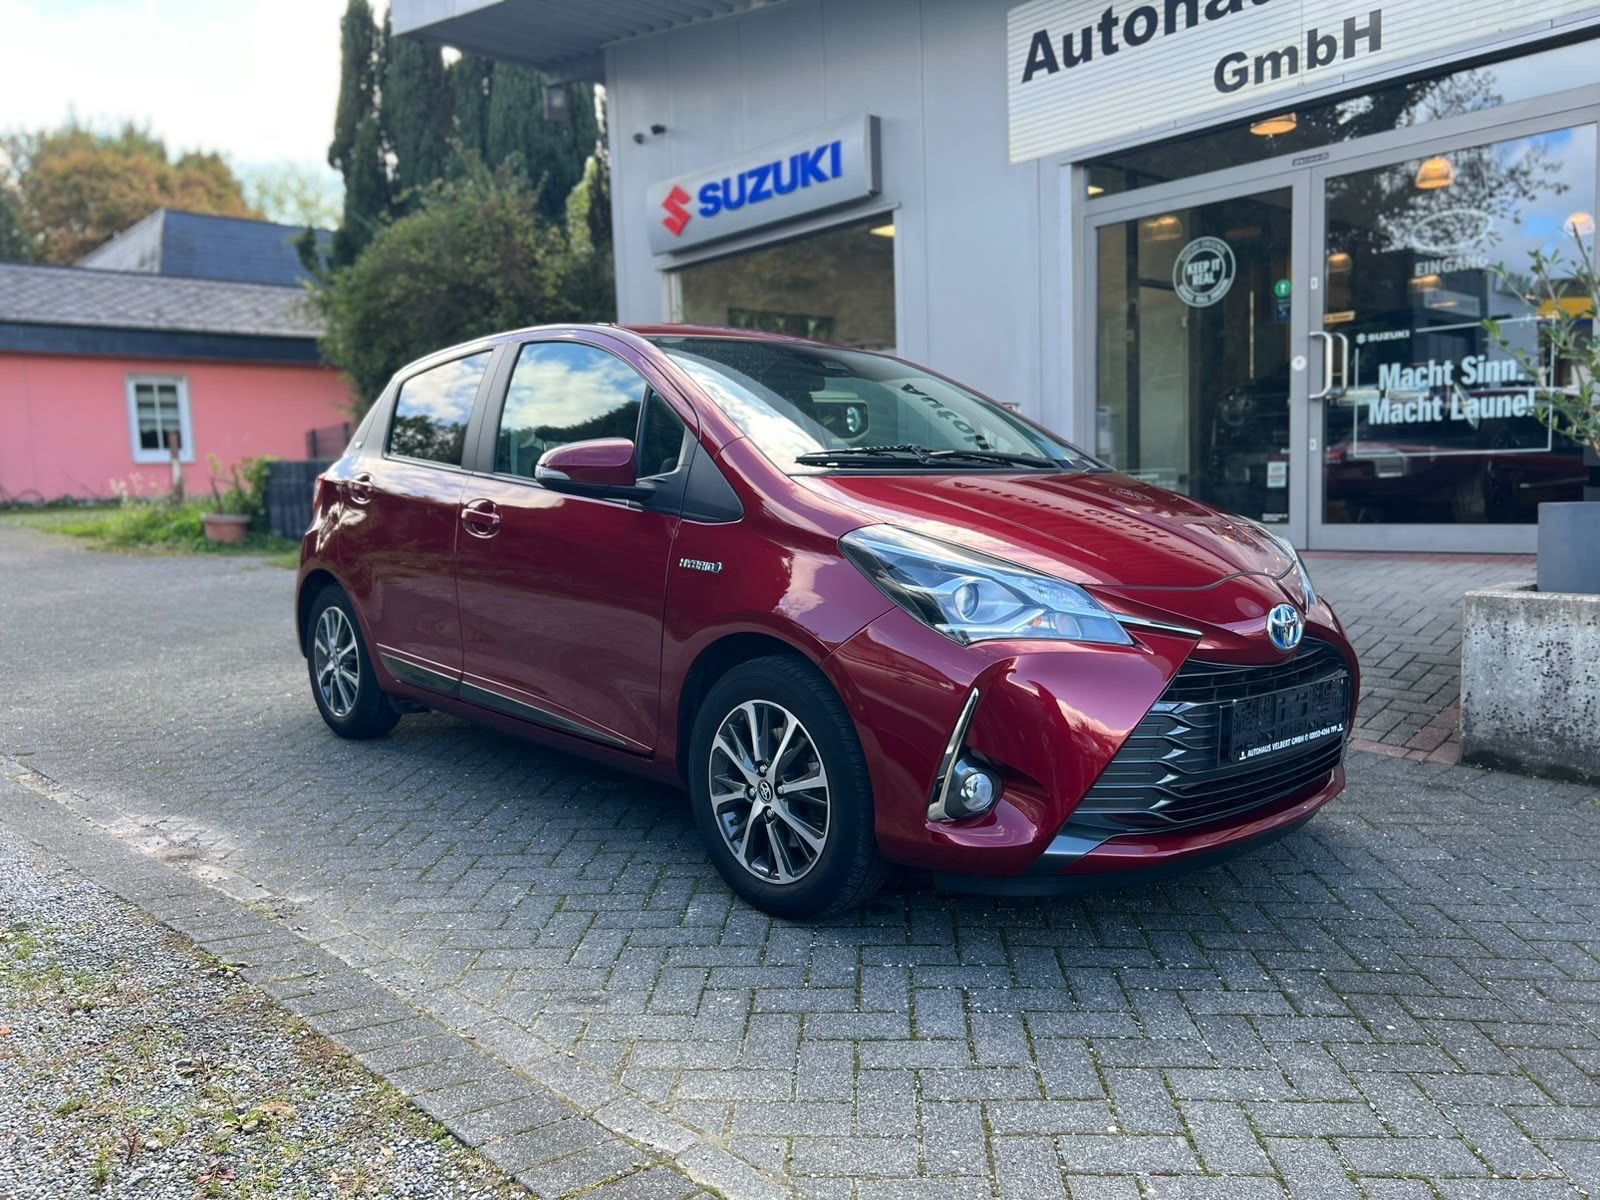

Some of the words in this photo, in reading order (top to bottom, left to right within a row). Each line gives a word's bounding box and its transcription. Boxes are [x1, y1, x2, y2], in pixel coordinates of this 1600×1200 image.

[1214, 9, 1382, 93] GmbH
[698, 141, 842, 218] SUZUKI
[1187, 260, 1210, 276] KEEP
[1211, 258, 1220, 271] IT
[1414, 254, 1490, 277] EINGANG
[1192, 271, 1216, 286] REAL
[1367, 329, 1410, 342] SUZUKI
[1378, 359, 1454, 391] Macht
[1460, 354, 1525, 386] Sinn.
[1368, 391, 1443, 425] Macht
[1450, 387, 1536, 421] Laune!
[1247, 744, 1272, 757] AUTOHAUS
[1272, 738, 1291, 750] VELBERT
